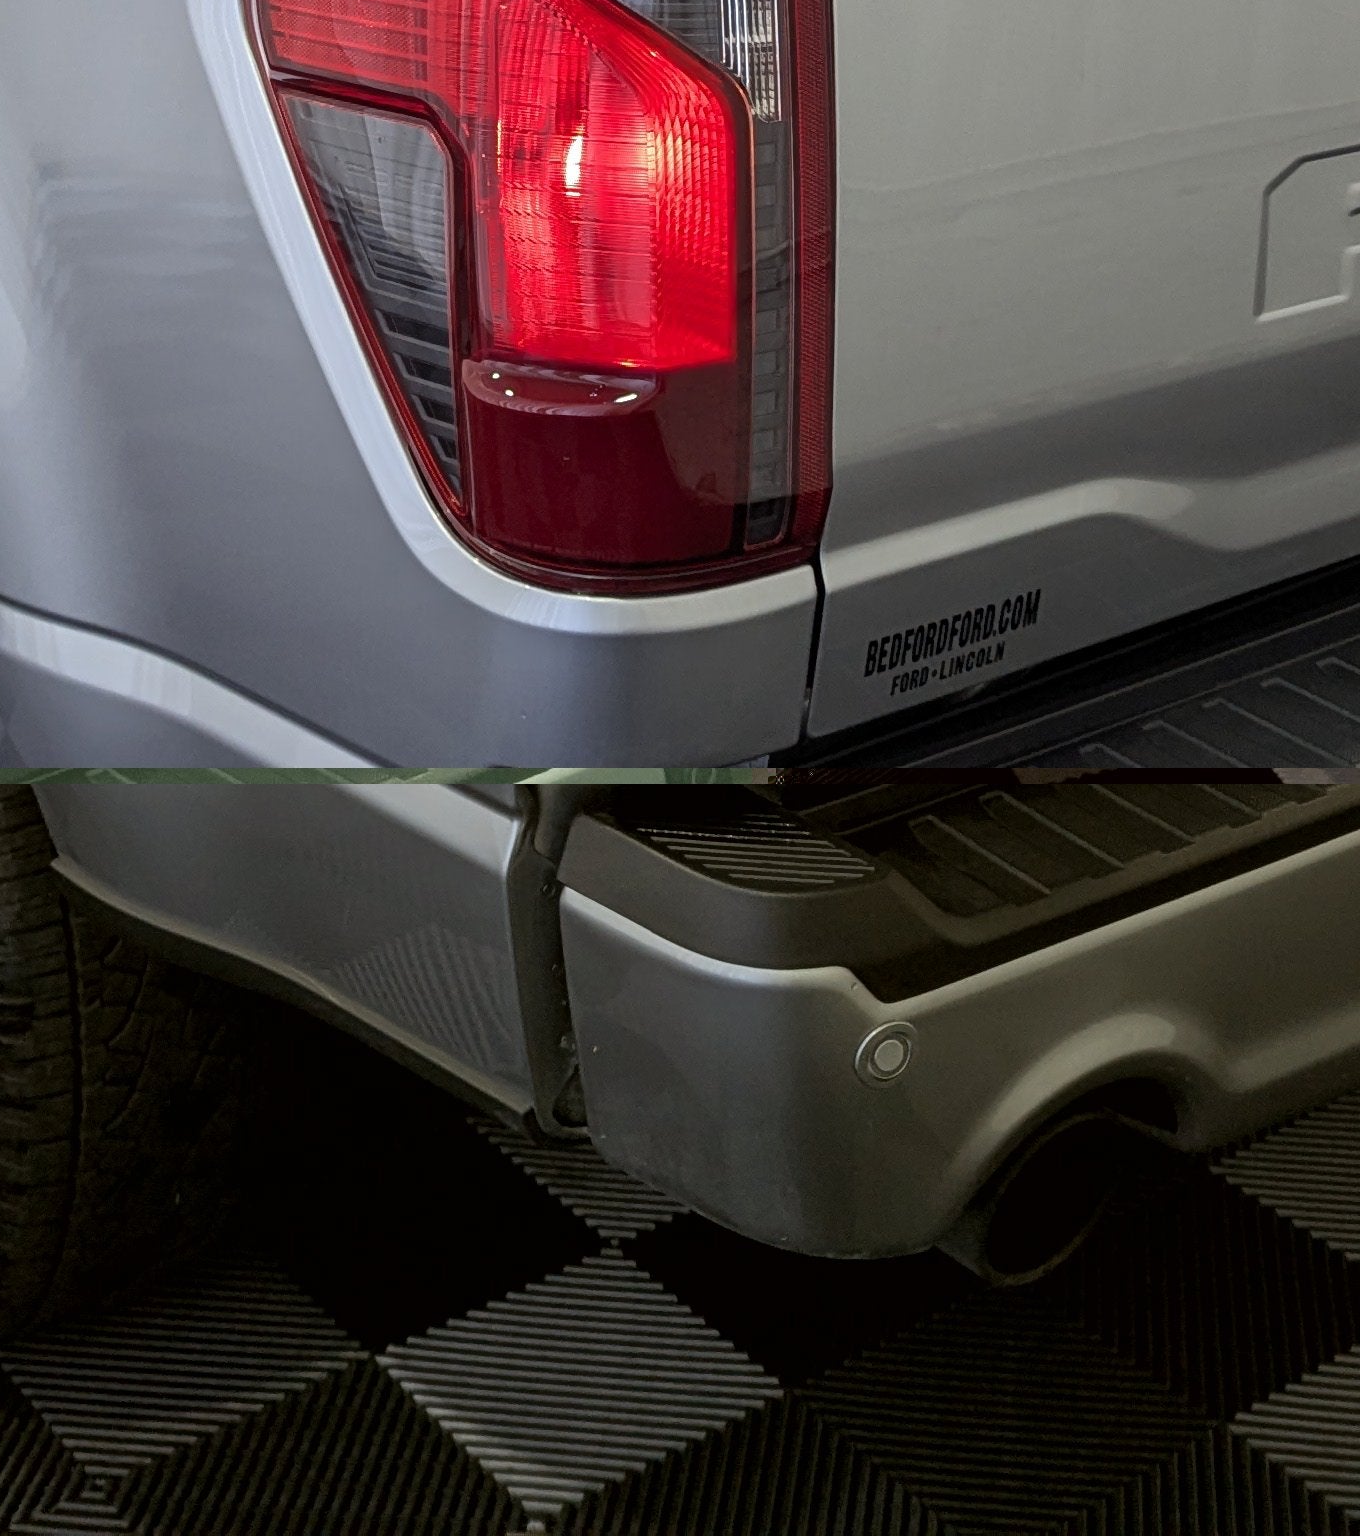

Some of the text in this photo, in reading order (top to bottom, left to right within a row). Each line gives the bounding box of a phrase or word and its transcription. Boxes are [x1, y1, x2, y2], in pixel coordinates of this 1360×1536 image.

[863, 588, 1042, 678] BEDFORDFORD.COM
[890, 641, 1006, 696] FORD LINCOLN
